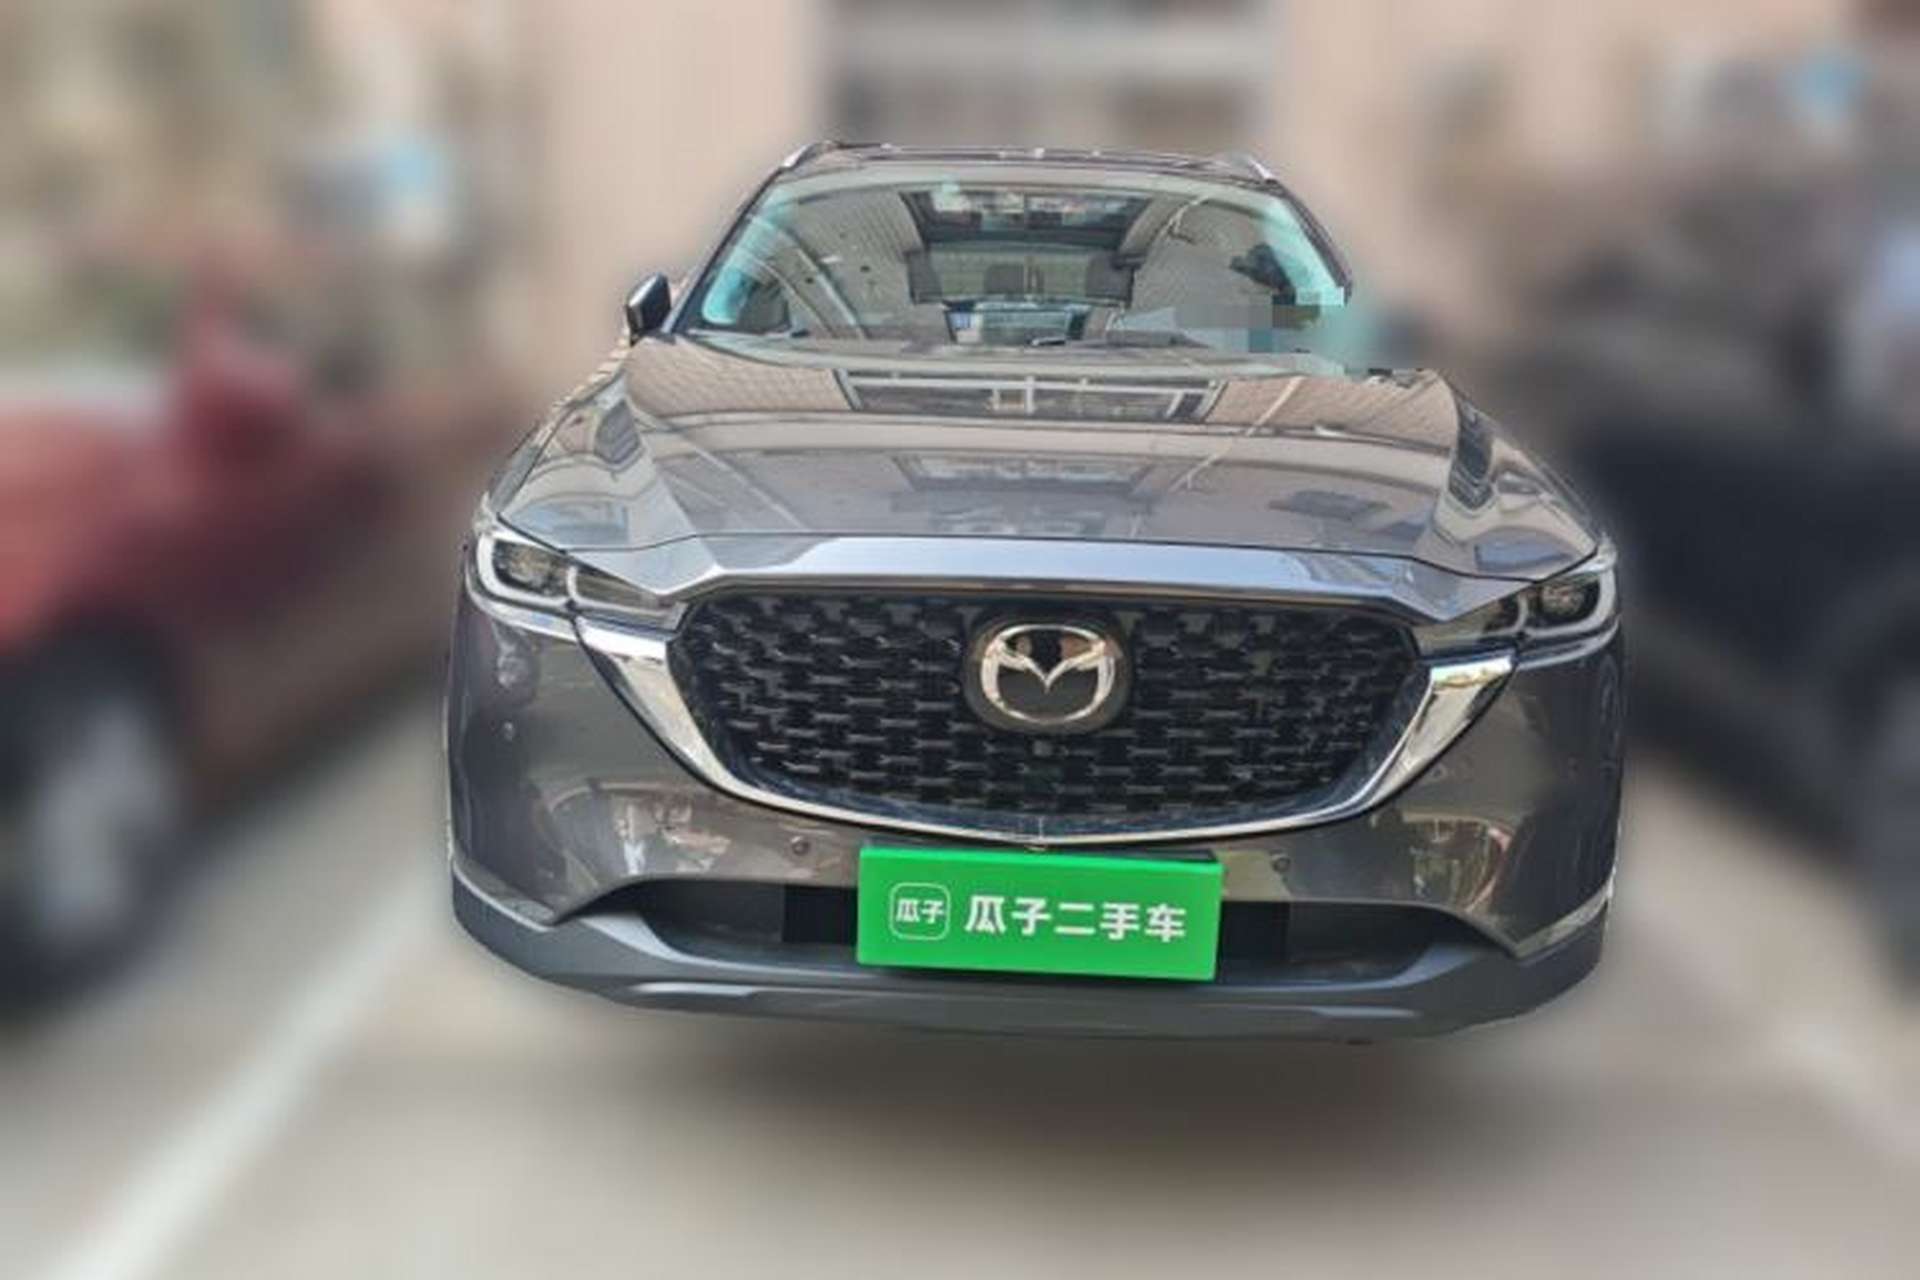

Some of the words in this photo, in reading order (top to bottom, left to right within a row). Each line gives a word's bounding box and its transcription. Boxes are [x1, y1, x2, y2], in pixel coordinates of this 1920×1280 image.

[895, 899, 944, 924] 瓜子
[964, 894, 1187, 942] 瓜子二手车
